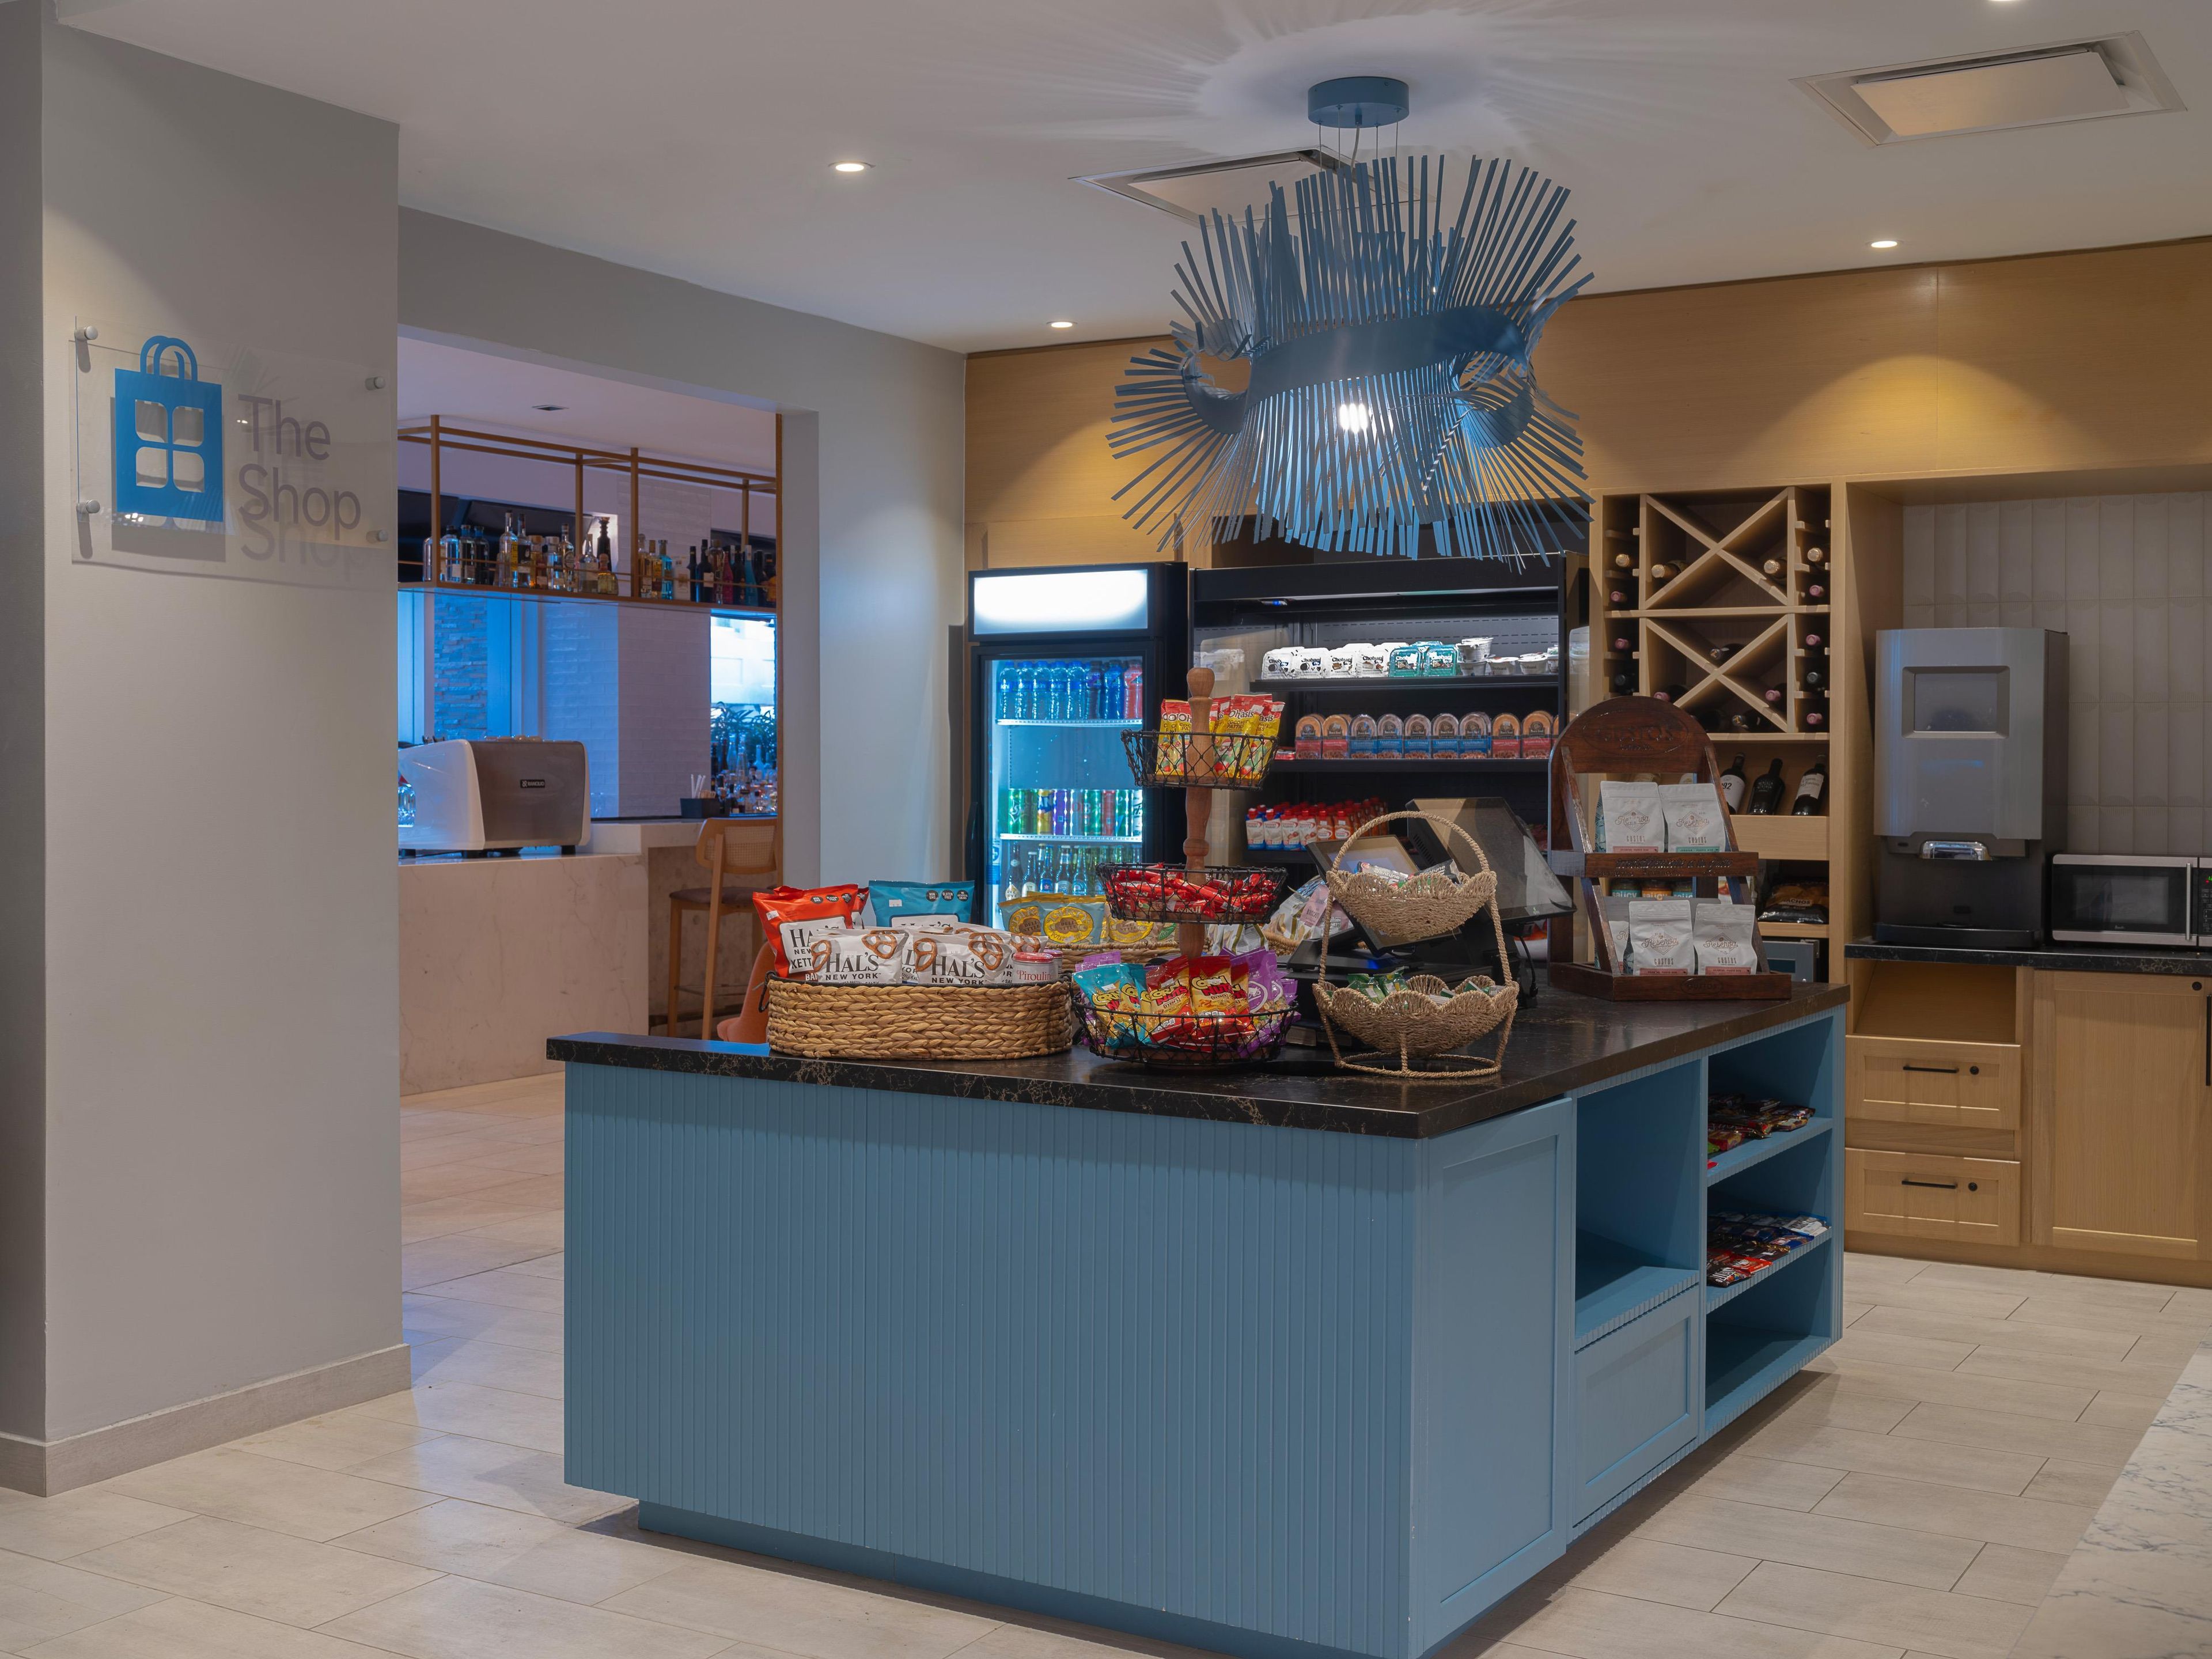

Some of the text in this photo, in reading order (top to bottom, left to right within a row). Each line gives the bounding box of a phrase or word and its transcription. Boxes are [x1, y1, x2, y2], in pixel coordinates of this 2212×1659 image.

[238, 394, 331, 460] The
[238, 464, 361, 540] Shop
[791, 958, 812, 969] KETT
[826, 952, 879, 973] HAL'S
[931, 955, 986, 979] HAL'S
[1155, 986, 1188, 1006] NUTS
